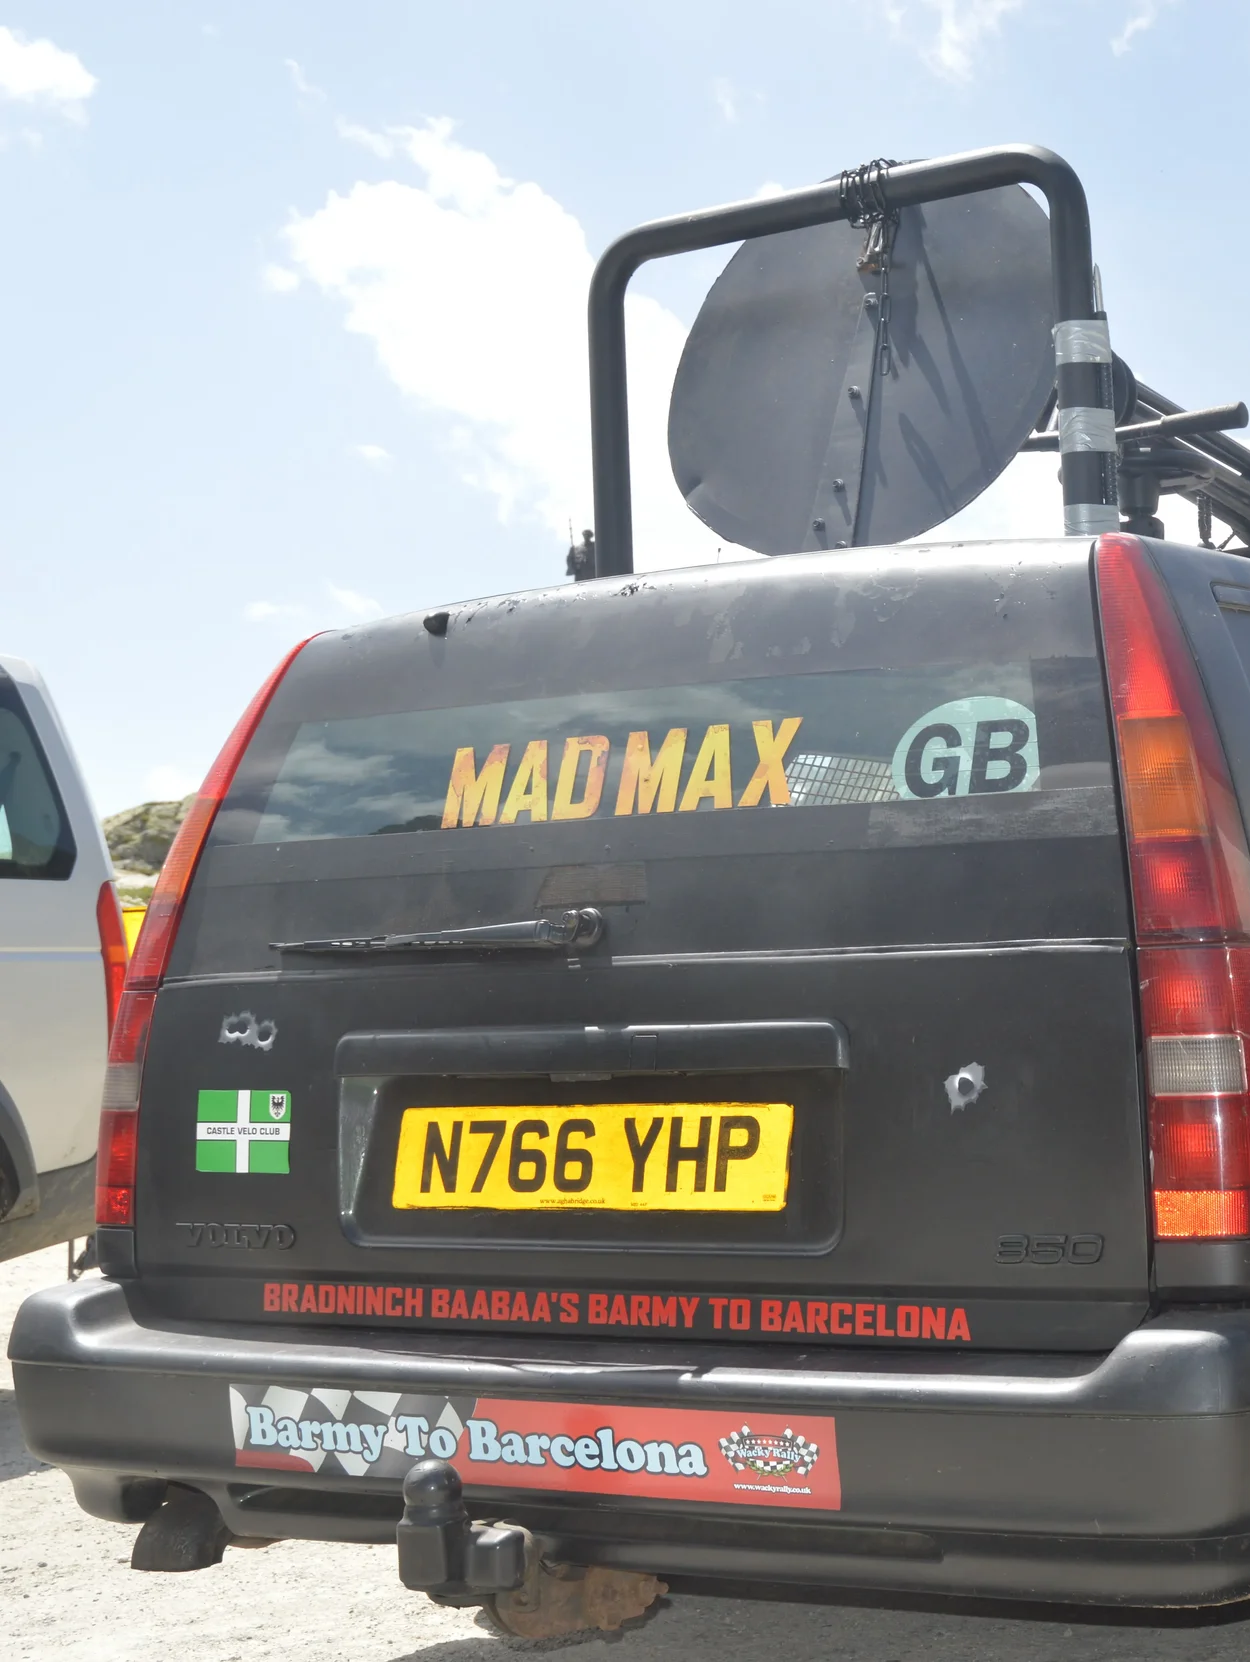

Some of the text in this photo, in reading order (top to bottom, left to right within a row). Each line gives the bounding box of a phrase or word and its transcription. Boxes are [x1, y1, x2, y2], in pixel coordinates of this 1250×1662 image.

[440, 717, 804, 829] MAD MAX
[904, 718, 1031, 798] GB
[206, 1127, 281, 1135] CASTLE VELO CLUB
[420, 1115, 761, 1194] N766 YHP
[175, 1222, 296, 1250] VOLVO
[263, 1283, 972, 1341] BRADNINCH BAABAA'S BARMY TO BARCELONA
[245, 1405, 712, 1479] Barmy To Barcelona
[736, 1447, 802, 1463] Wacky Rally
[733, 1482, 812, 1495] www.wackyrally.co.uk
